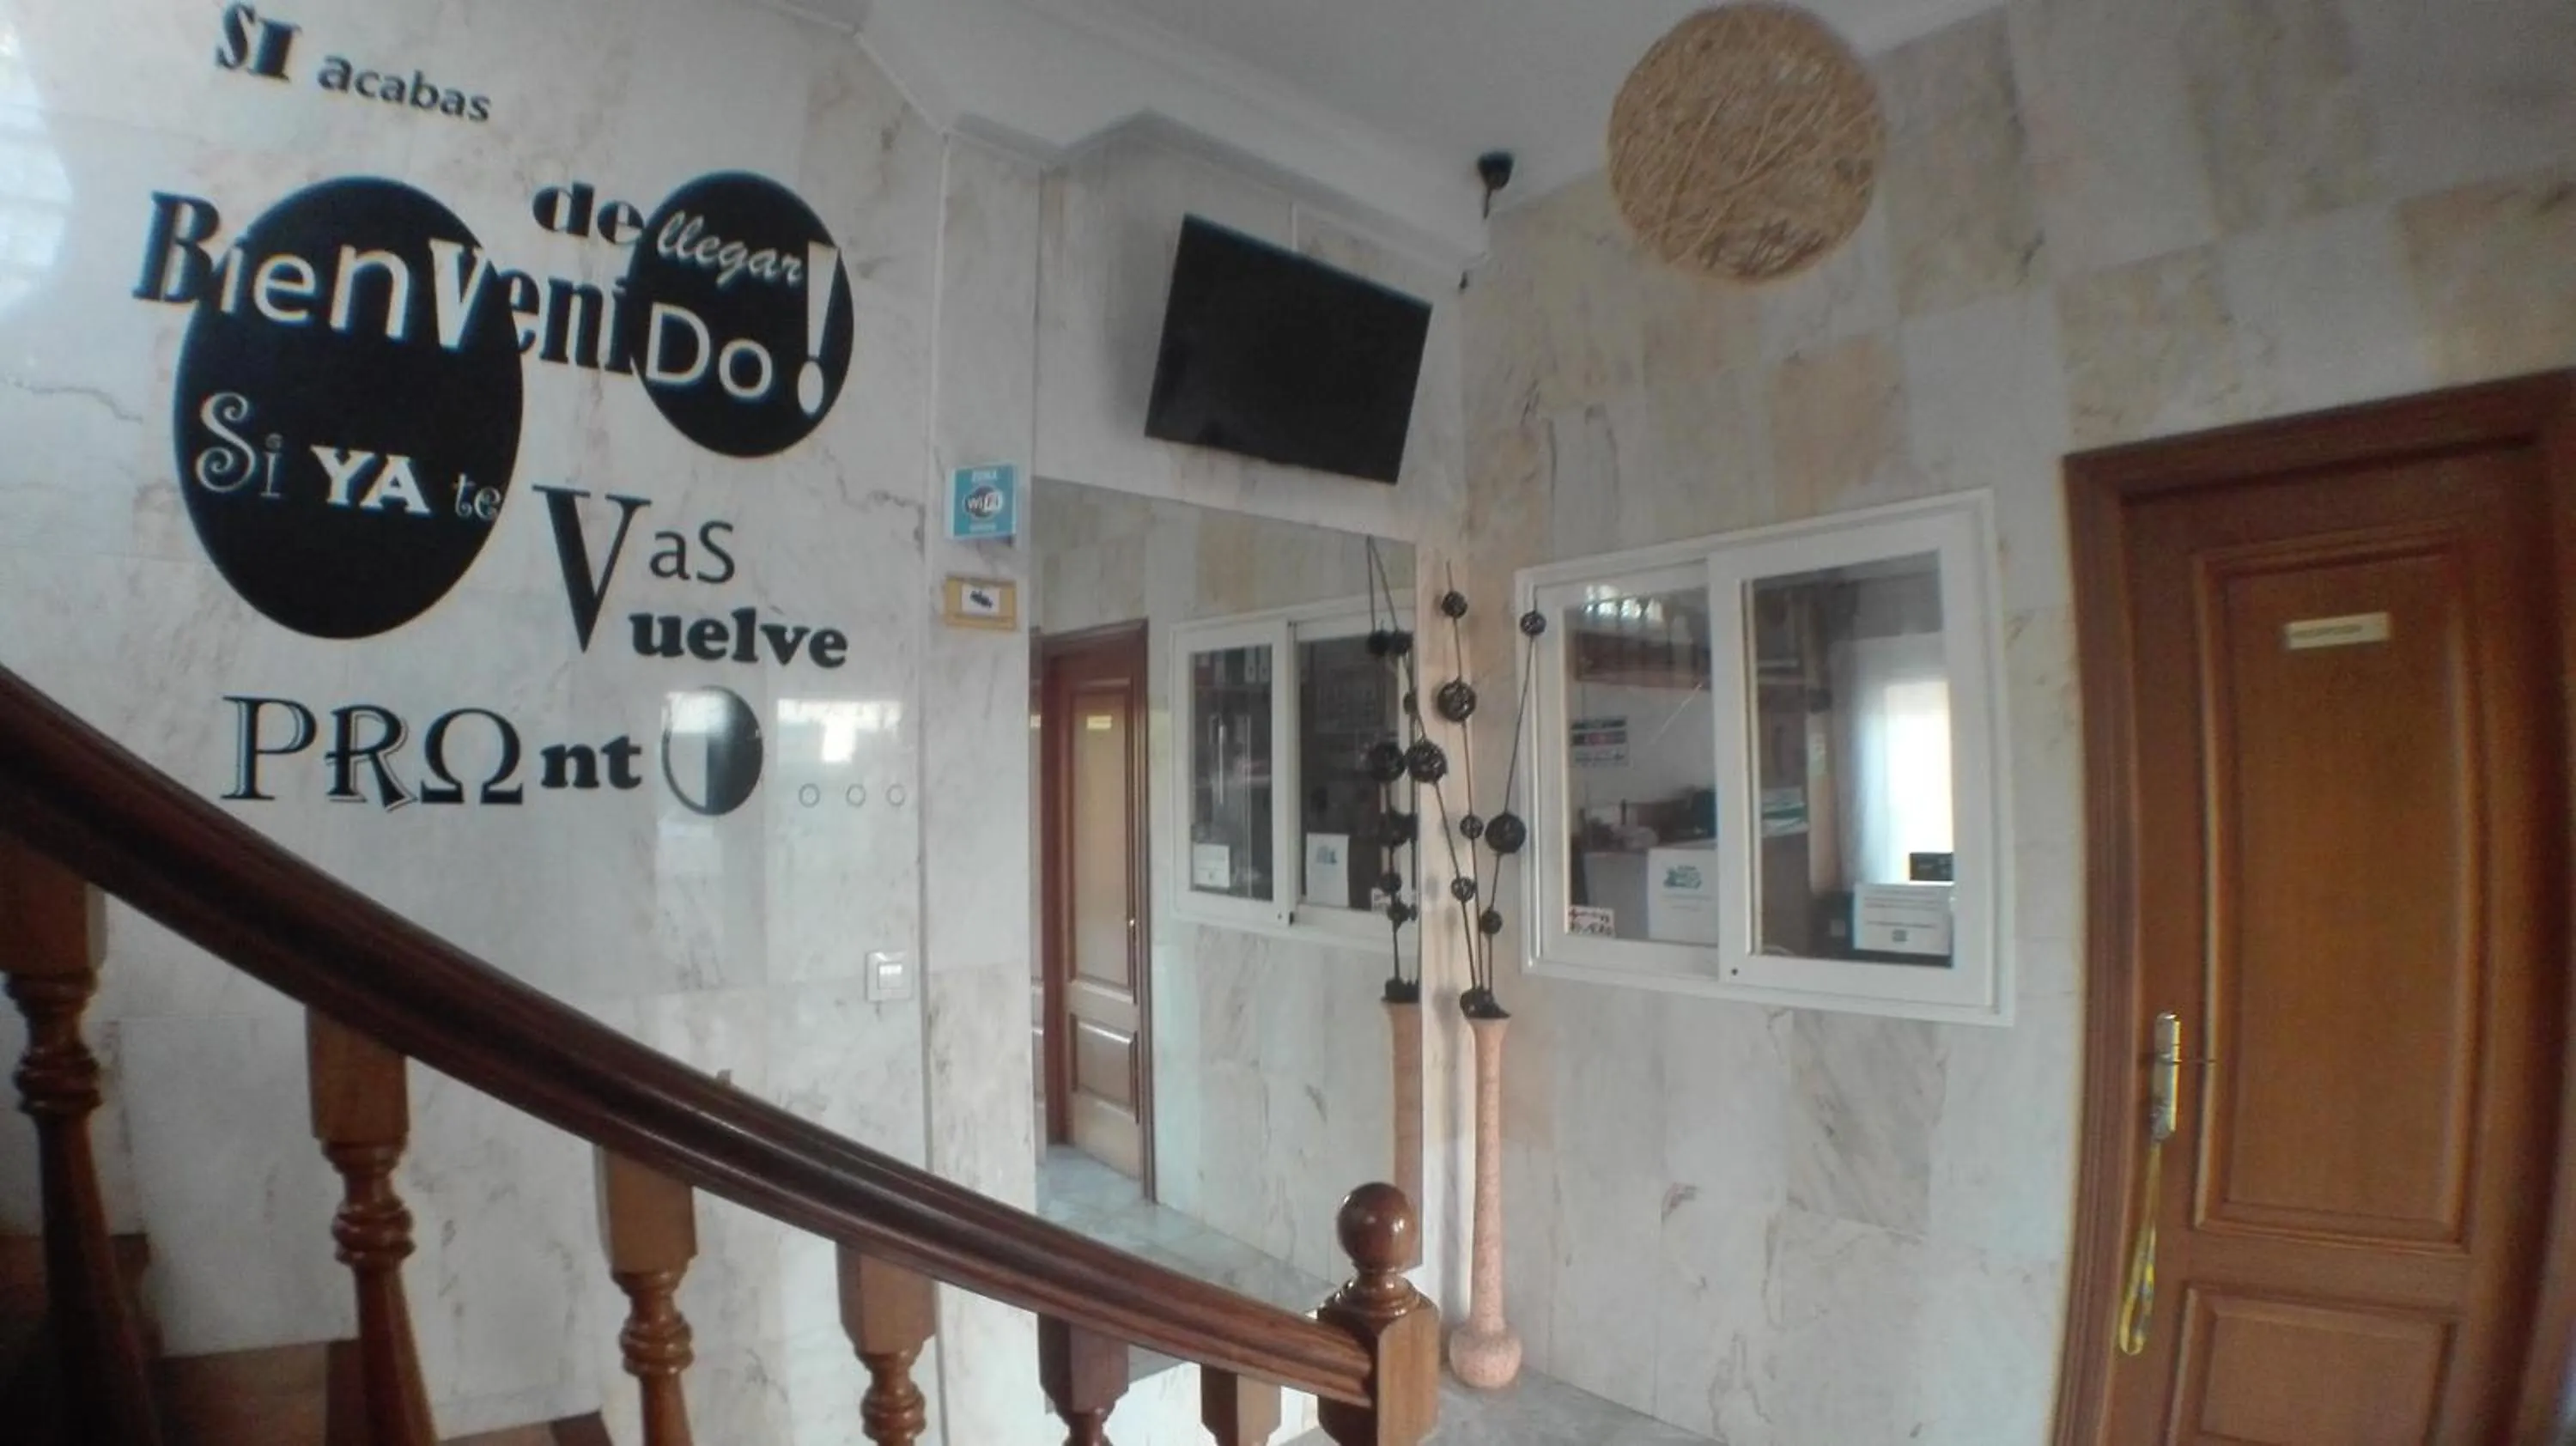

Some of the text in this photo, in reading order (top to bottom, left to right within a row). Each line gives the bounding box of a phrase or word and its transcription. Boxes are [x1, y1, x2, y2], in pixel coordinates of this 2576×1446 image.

[316, 54, 491, 123] acabas
[532, 180, 805, 289] de llegar
[194, 392, 502, 519] Si YA te
